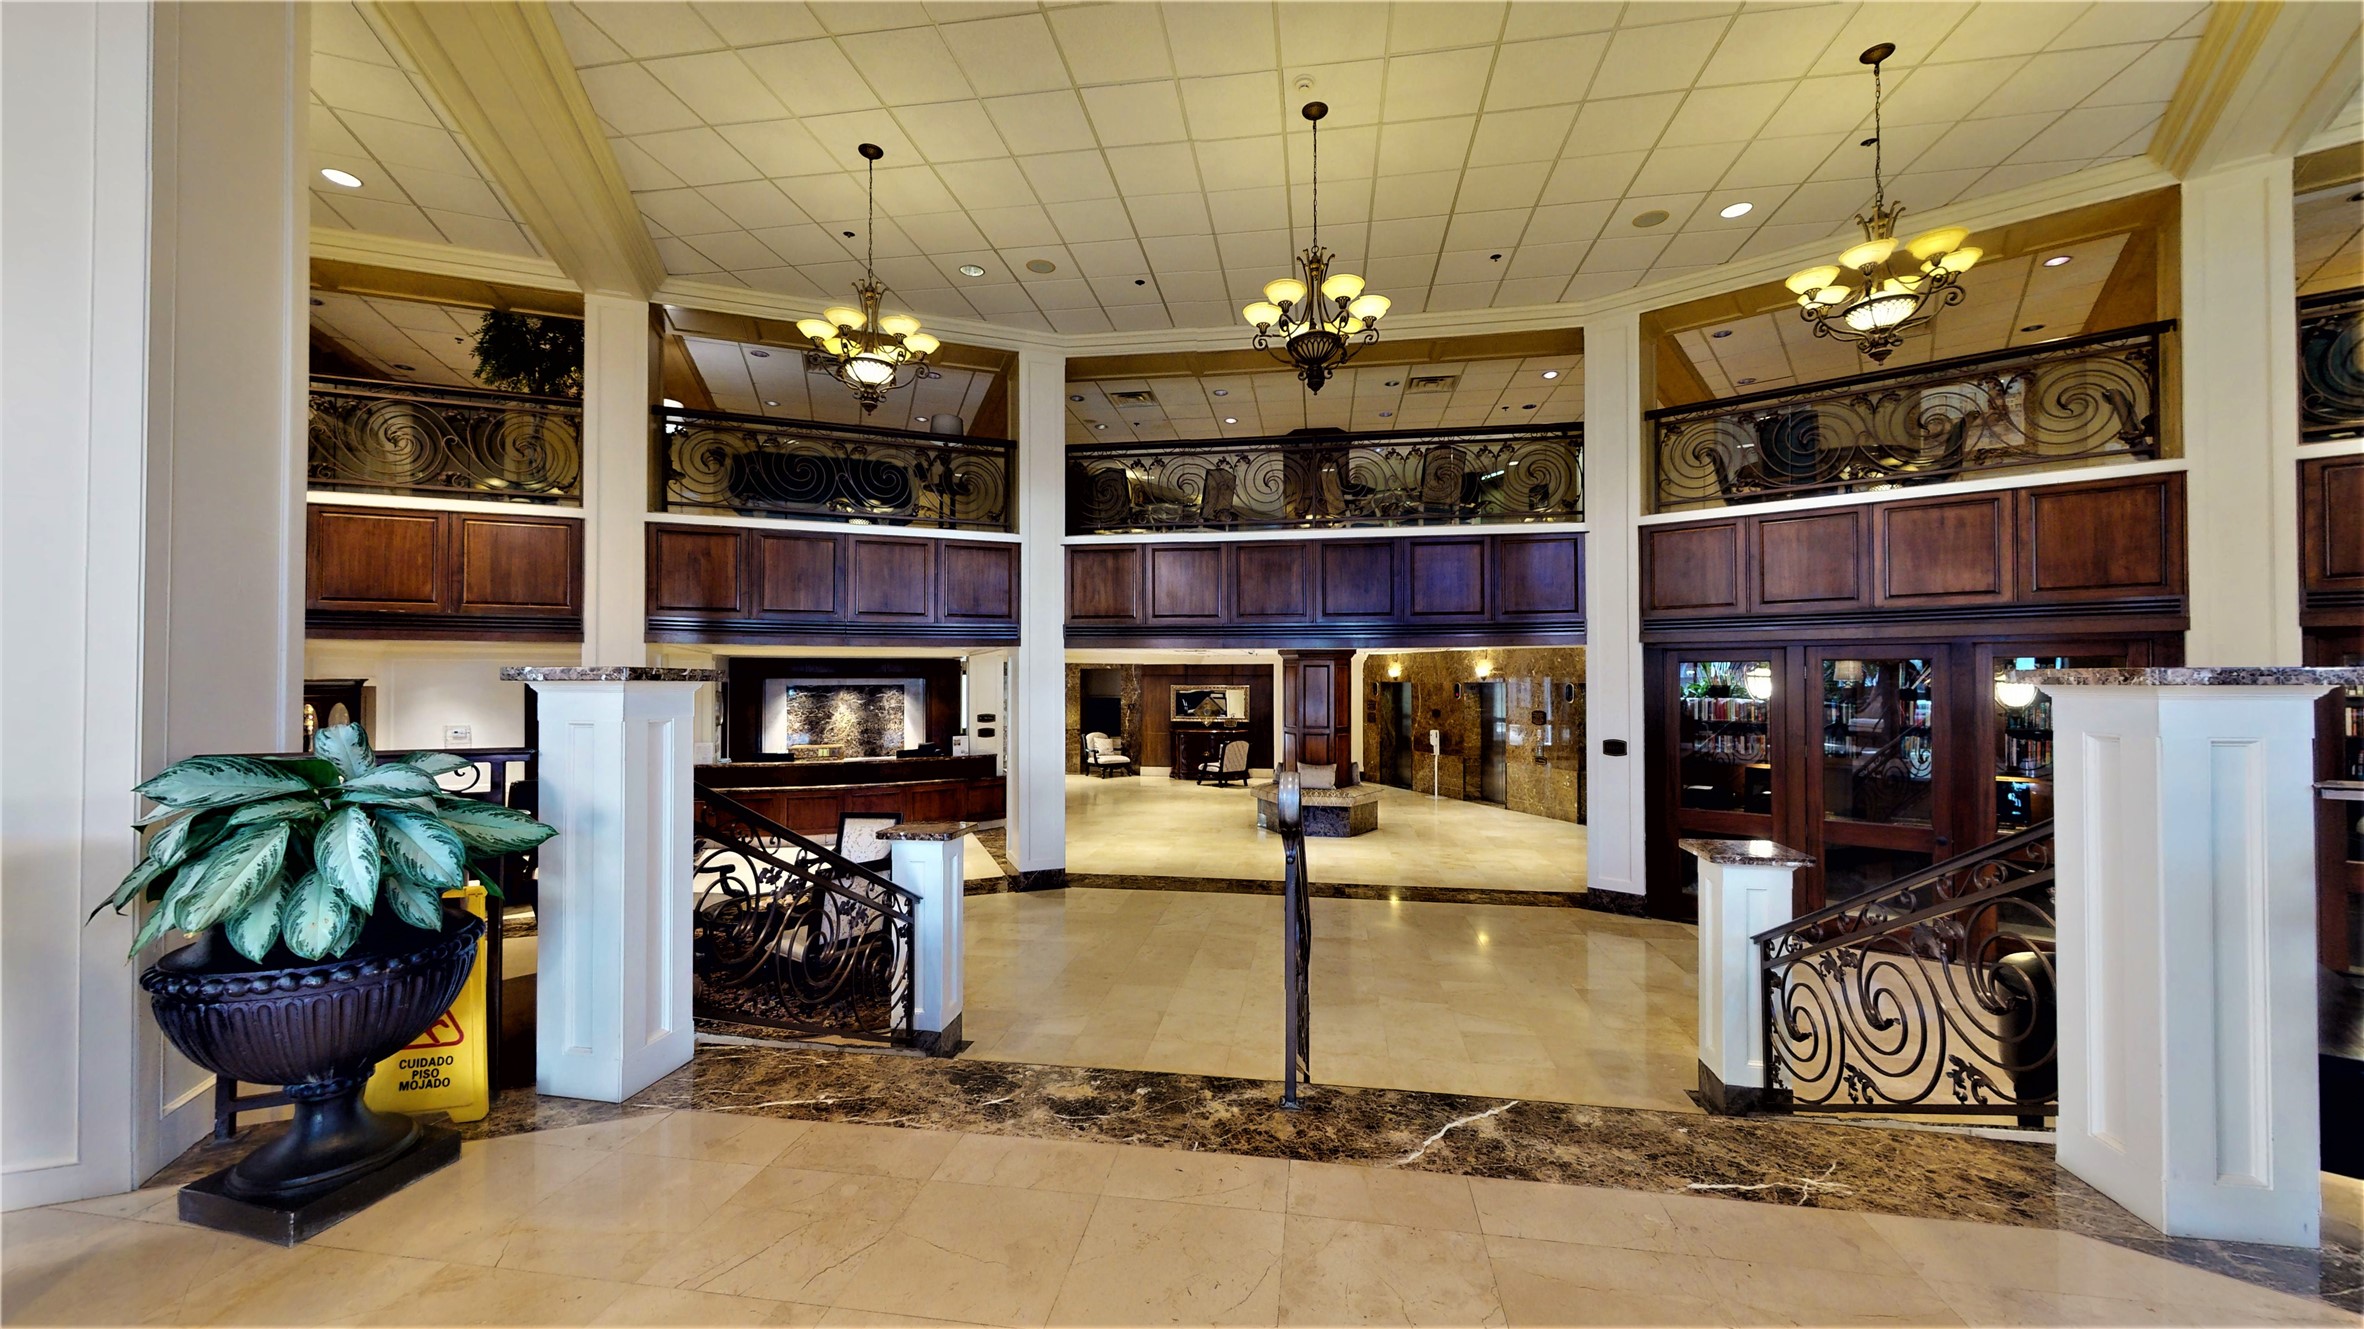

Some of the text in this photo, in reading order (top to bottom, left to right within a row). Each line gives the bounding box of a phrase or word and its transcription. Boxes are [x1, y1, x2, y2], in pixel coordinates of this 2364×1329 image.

[399, 1055, 454, 1069] CUIDADO
[412, 1068, 439, 1080] PISO
[399, 1077, 450, 1092] MOJADO
